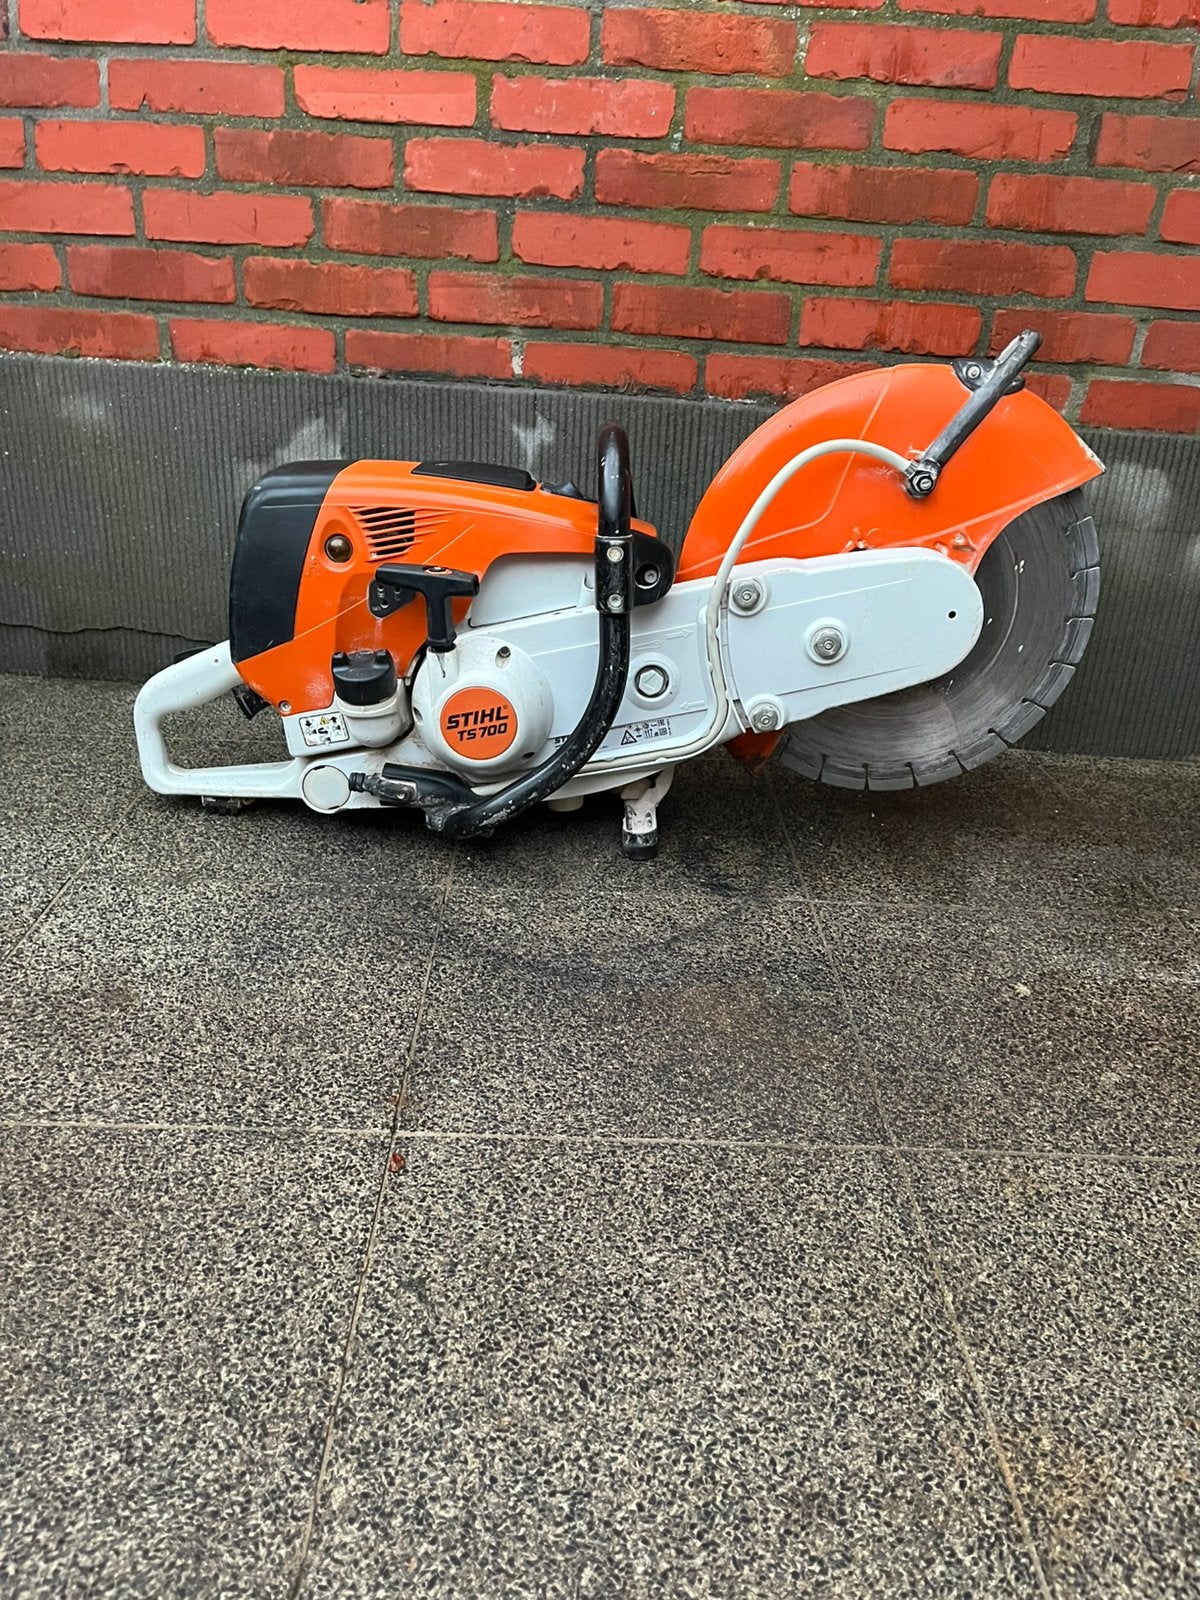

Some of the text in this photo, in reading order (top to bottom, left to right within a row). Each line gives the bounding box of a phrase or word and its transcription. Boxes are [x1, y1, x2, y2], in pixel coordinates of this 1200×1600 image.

[446, 706, 509, 730] STIHL
[457, 722, 508, 741] TS 700
